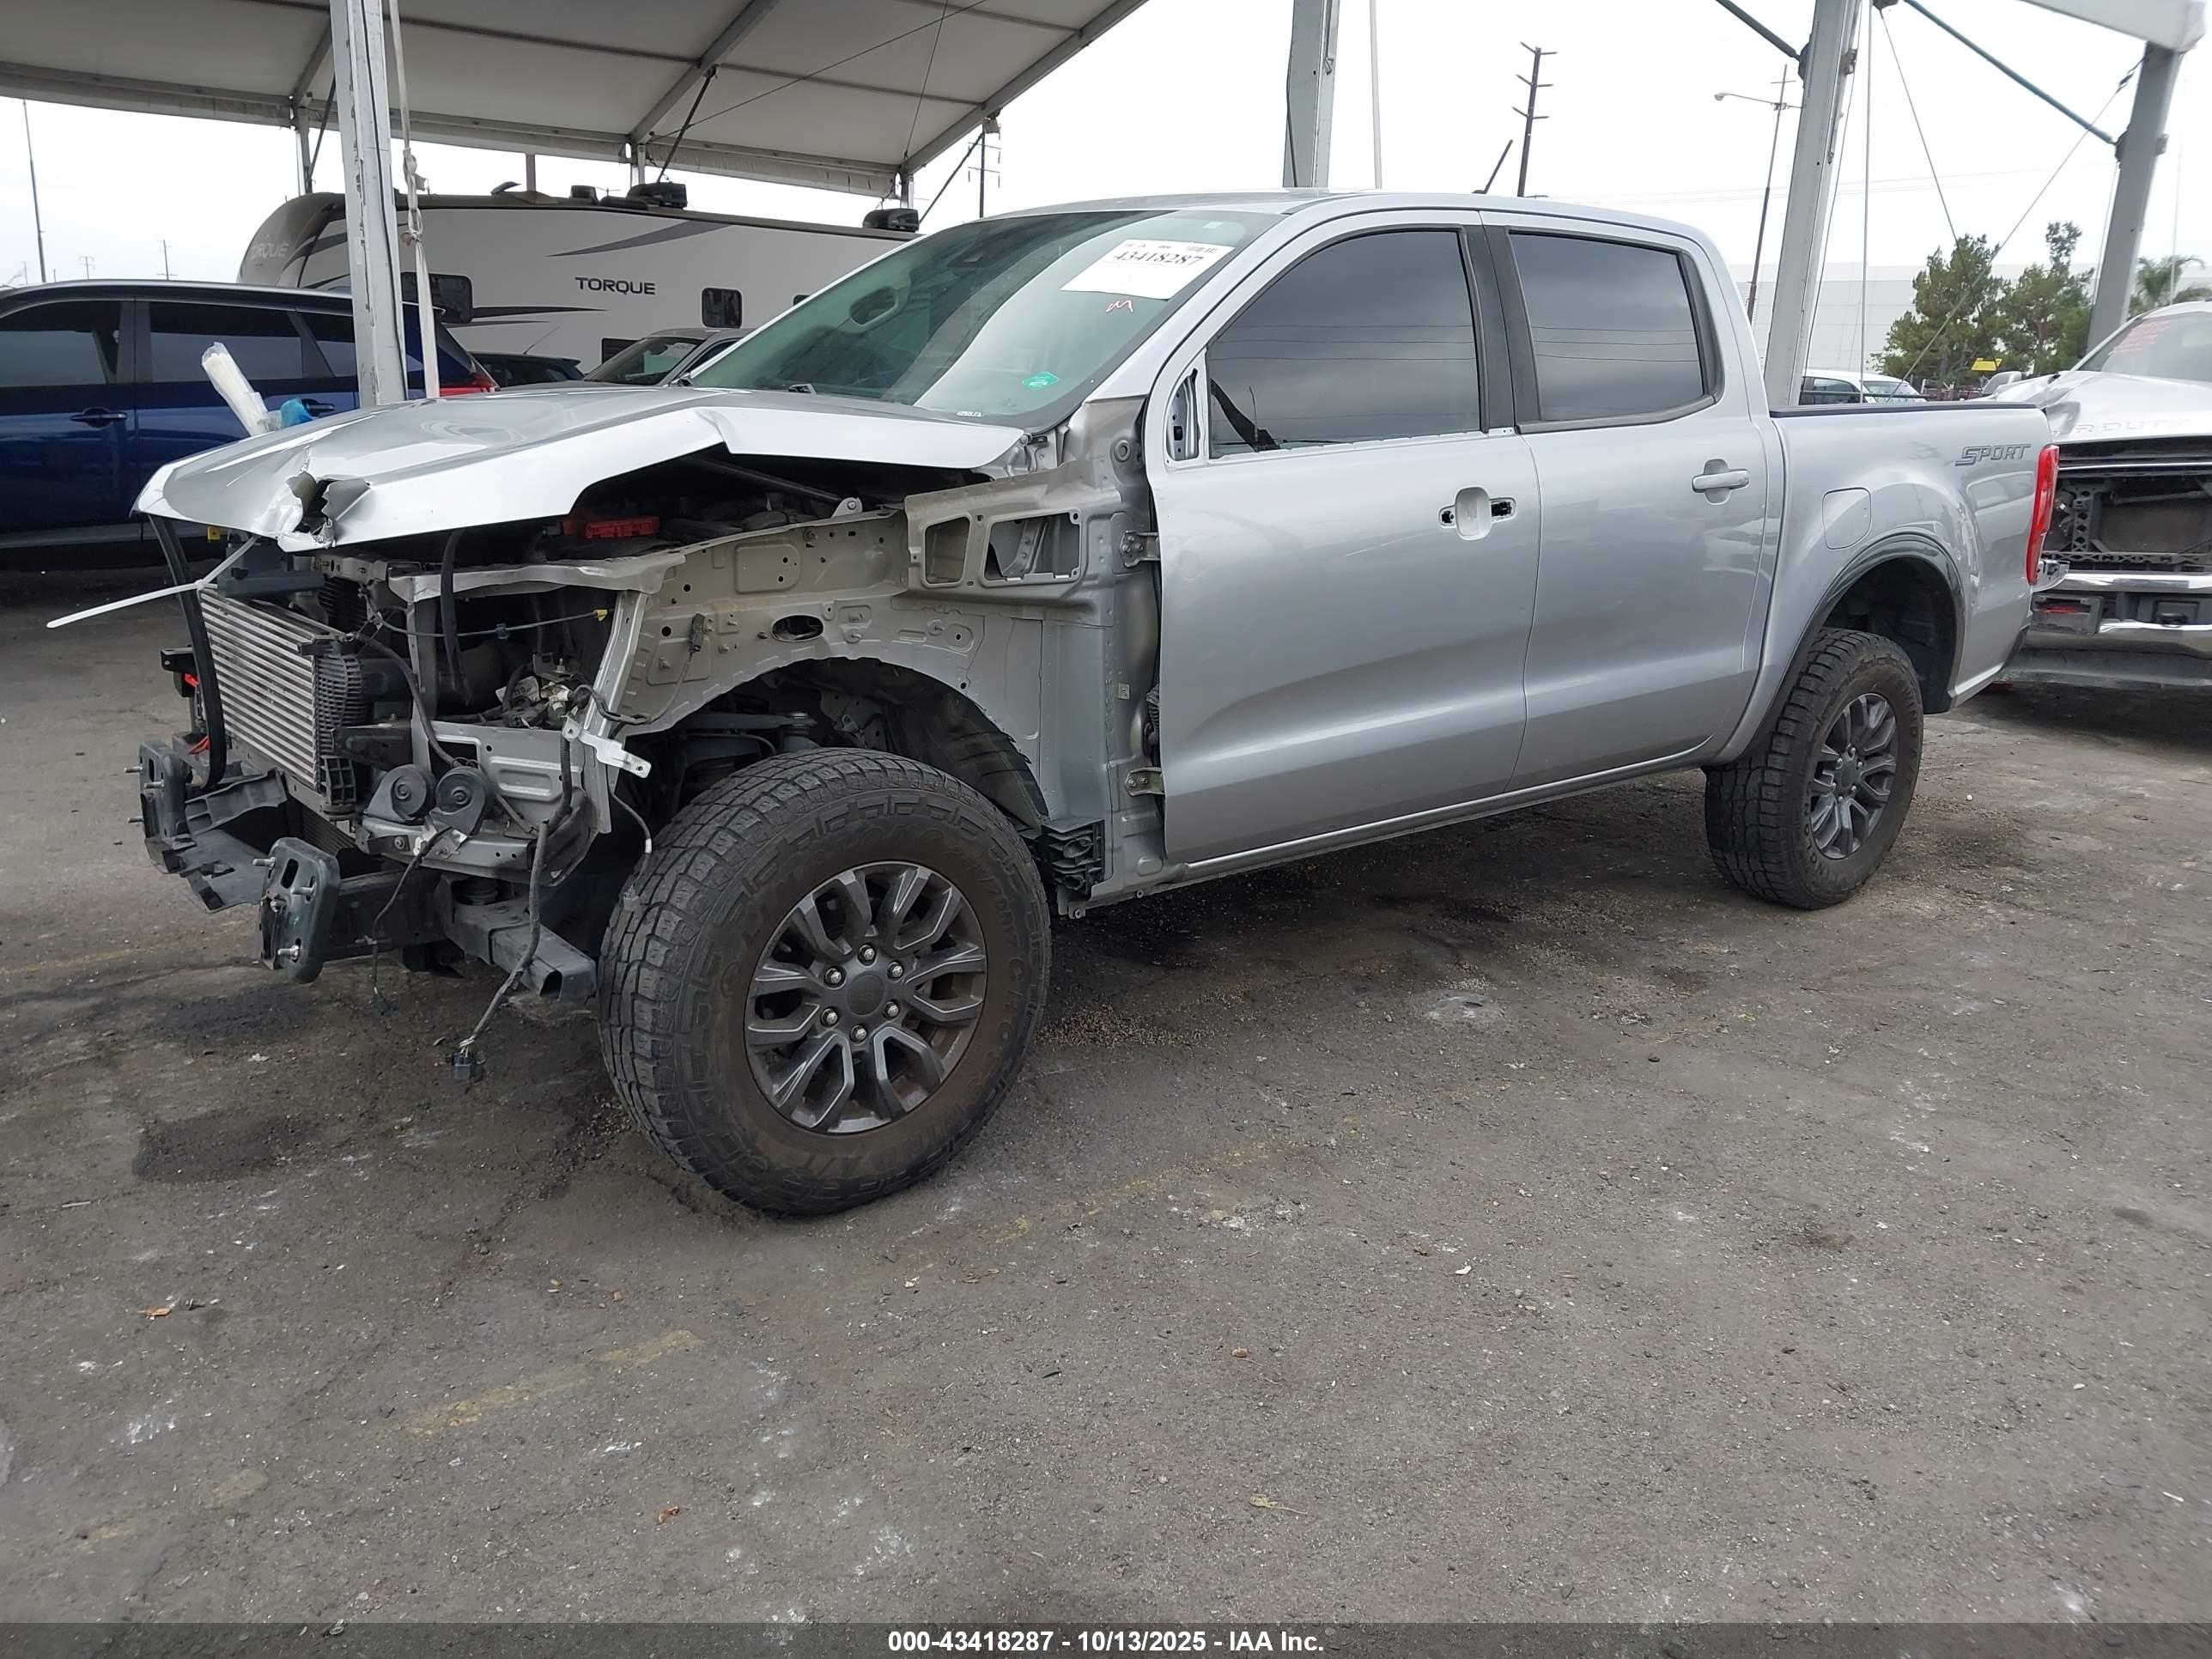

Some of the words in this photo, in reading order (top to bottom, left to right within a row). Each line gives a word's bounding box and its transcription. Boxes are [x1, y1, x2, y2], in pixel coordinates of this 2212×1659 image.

[1114, 250, 1206, 266] 43418287
[574, 276, 656, 295] TORQUE
[1954, 443, 2032, 467] SPORT
